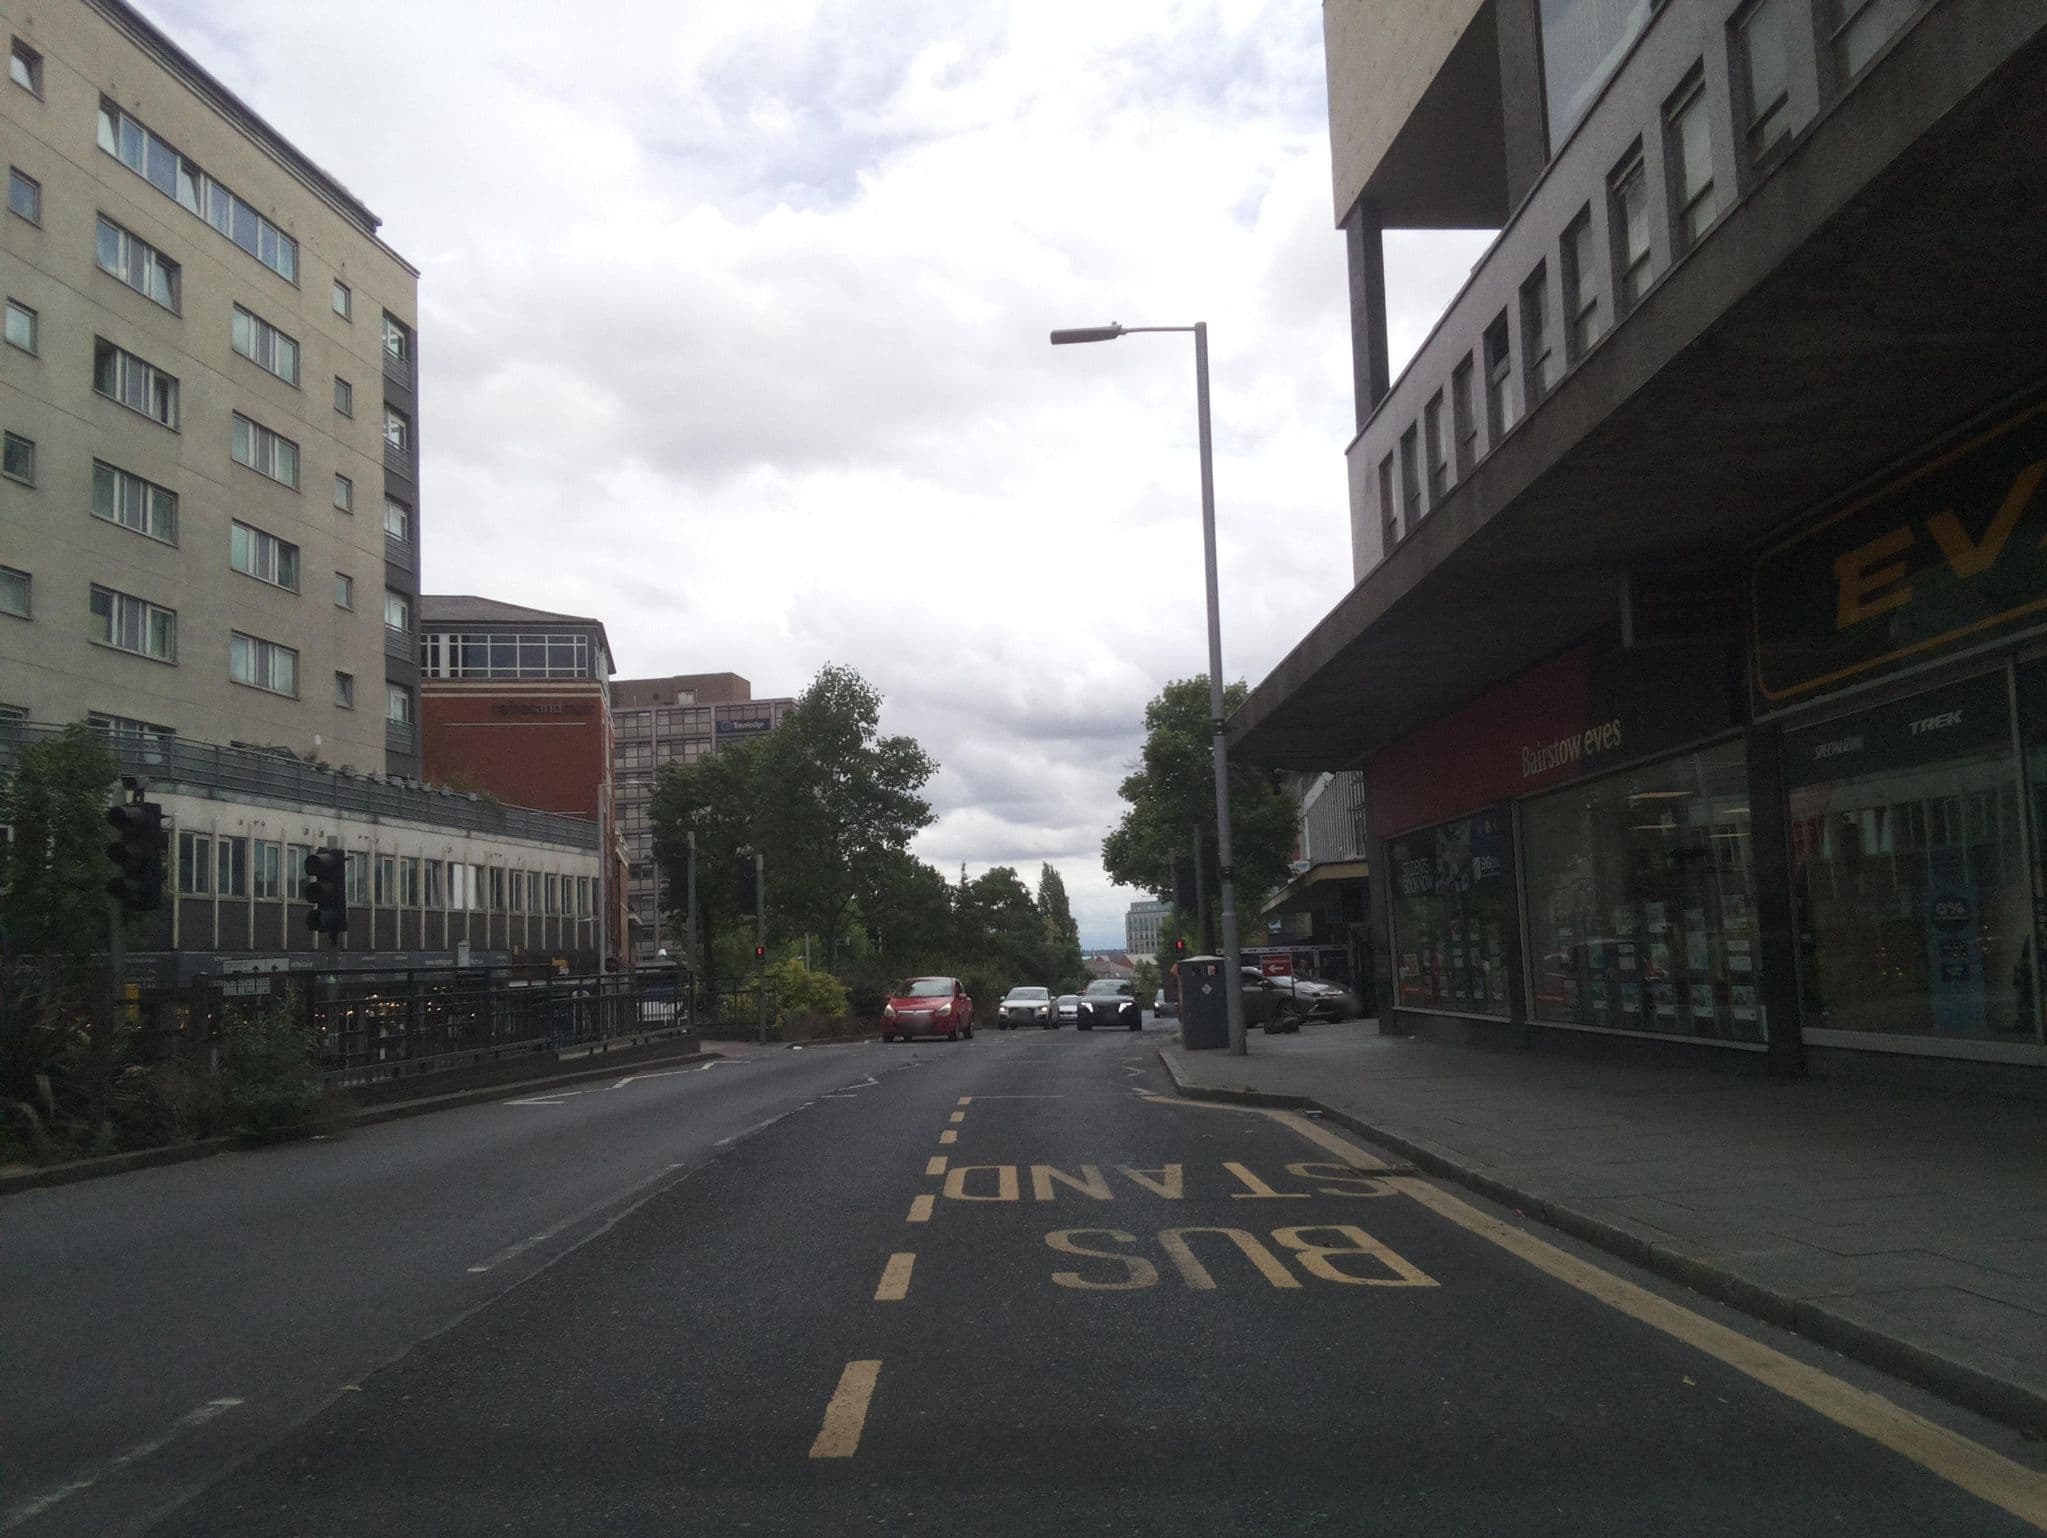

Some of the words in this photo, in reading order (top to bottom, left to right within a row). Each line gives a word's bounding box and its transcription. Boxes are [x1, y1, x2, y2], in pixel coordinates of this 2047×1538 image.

[1834, 459, 2047, 630] EV
[1521, 733, 1582, 778] Bairstow
[1584, 719, 1621, 755] eves
[1908, 710, 1963, 735] TREK
[942, 1162, 1400, 1201] STAND
[1044, 1224, 1442, 1290] BUS
